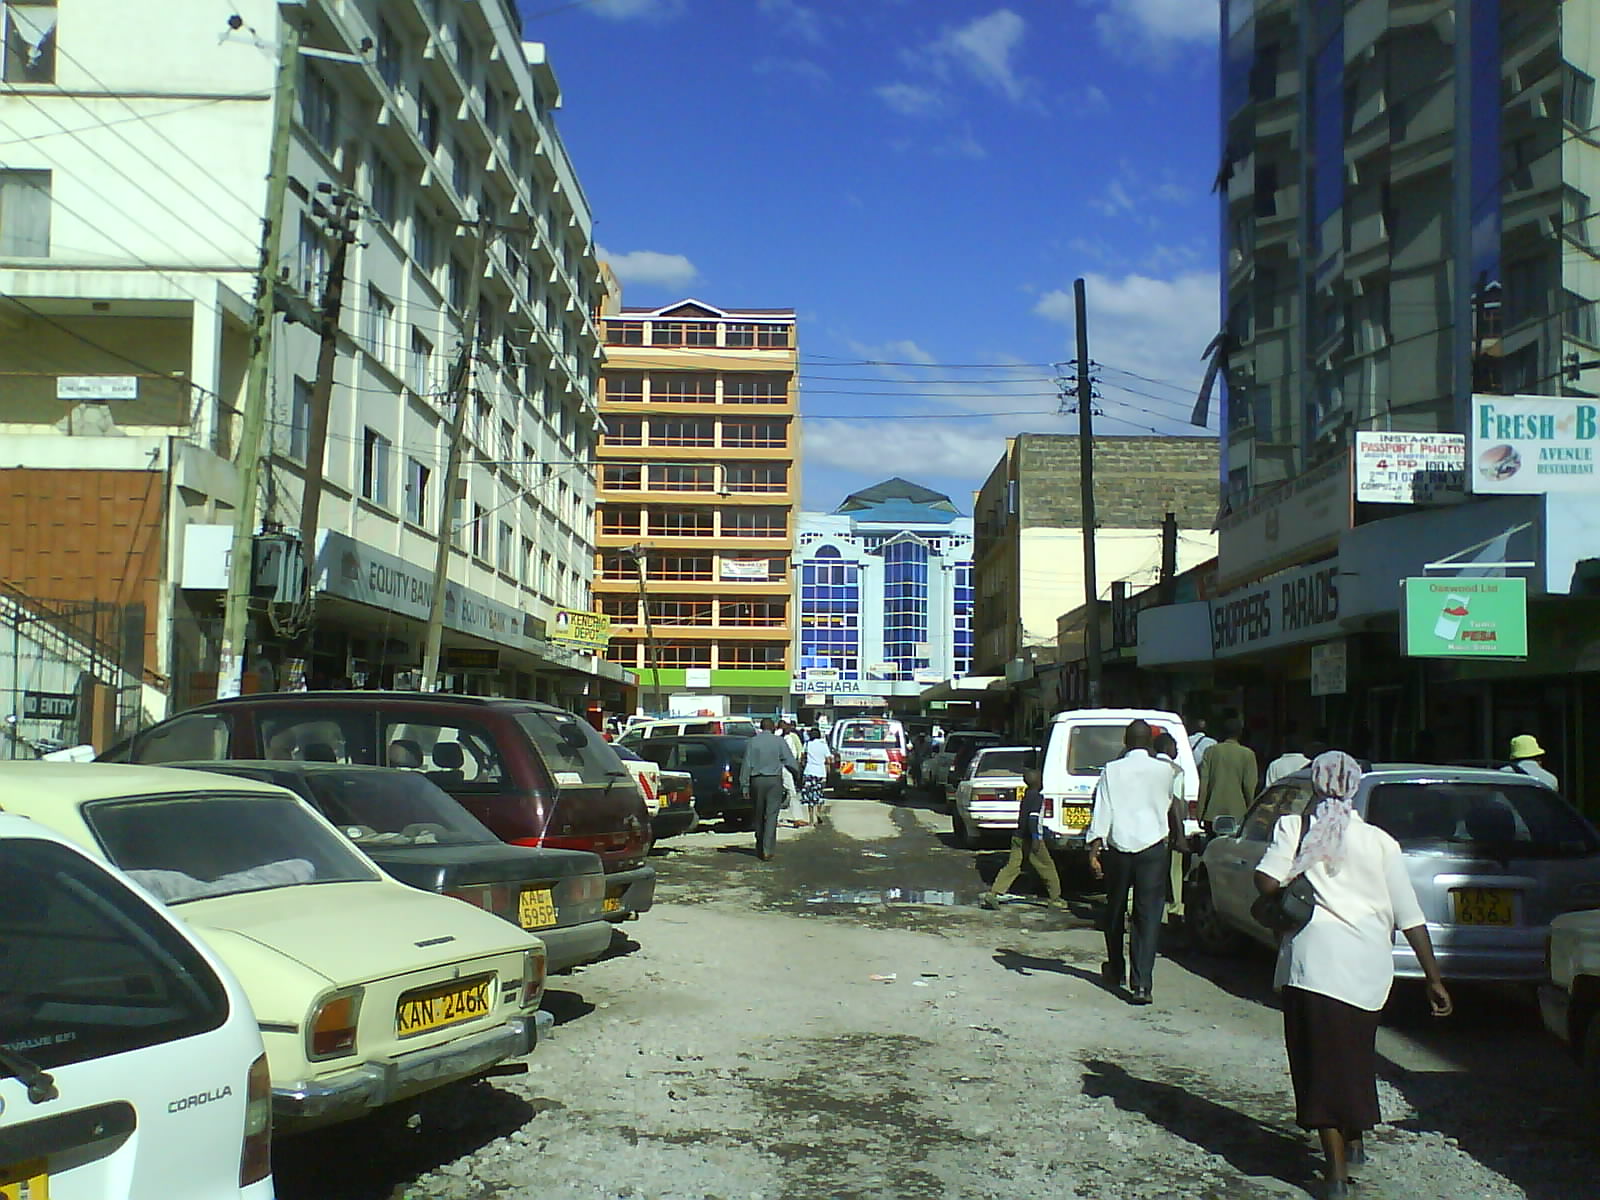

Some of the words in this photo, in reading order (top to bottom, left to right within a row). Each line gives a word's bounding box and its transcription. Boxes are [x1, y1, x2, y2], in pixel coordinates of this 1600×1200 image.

[1480, 404, 1555, 440] FRESH
[1576, 405, 1597, 440] B
[1361, 442, 1414, 453] PASSPORT
[1380, 435, 1435, 444] INSTANT
[1539, 447, 1593, 461] AVENUE
[1537, 463, 1594, 474] RESTAURANT
[368, 560, 410, 600] EQUITY
[411, 578, 433, 609] BAN
[461, 597, 488, 628] EQUITY
[1214, 590, 1271, 650] SHOPPERS
[795, 681, 860, 693] BIASHARA
[40, 697, 75, 715] ENTRY
[521, 889, 545, 907] KAE
[524, 905, 553, 926] 595P
[399, 999, 435, 1031] KAN
[442, 983, 489, 1020] 246K
[168, 1085, 233, 1113] COROLLA
